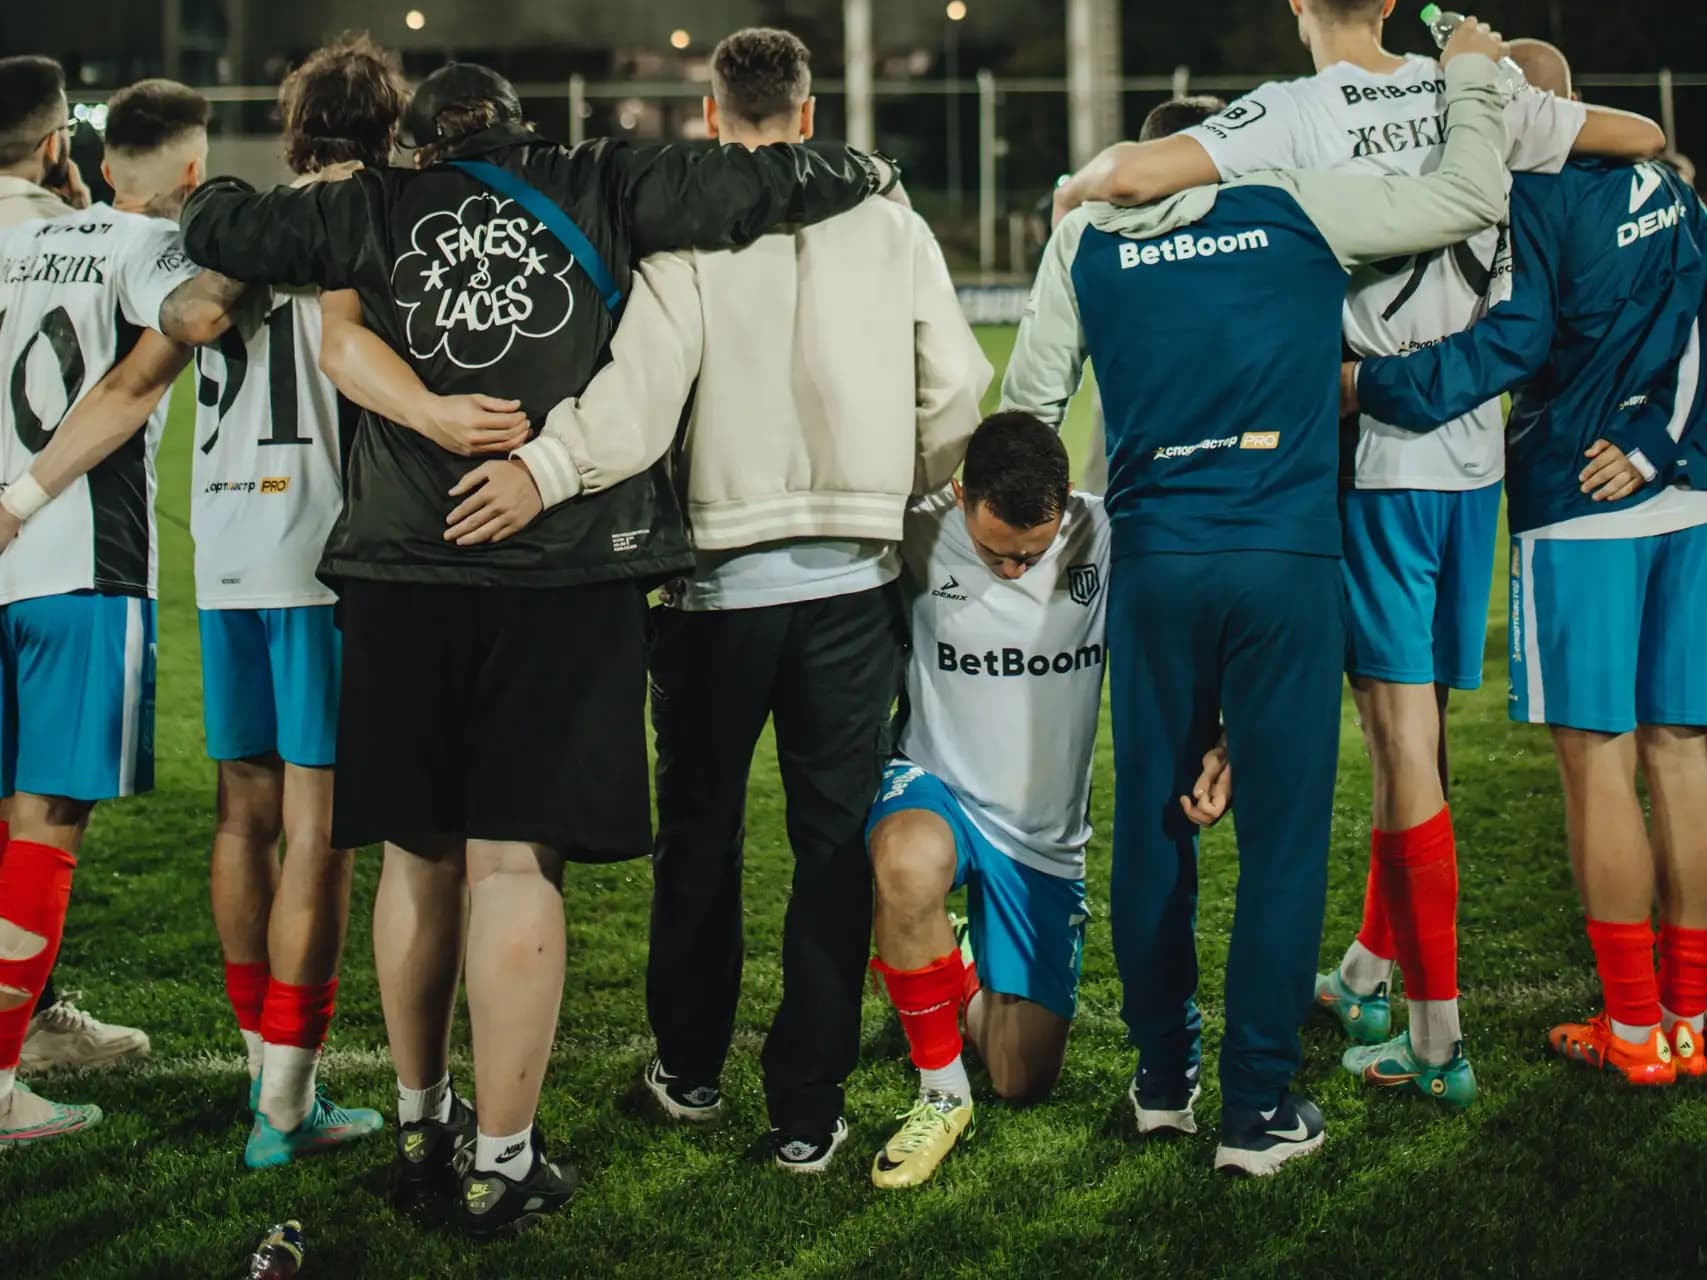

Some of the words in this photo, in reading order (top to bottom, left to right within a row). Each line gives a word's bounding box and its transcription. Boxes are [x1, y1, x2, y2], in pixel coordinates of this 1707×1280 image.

[435, 217, 529, 266] FACES
[1617, 200, 1686, 248] DEM
[1118, 228, 1269, 270] BetBoom
[435, 275, 533, 332] LACES
[261, 480, 287, 493] PRO
[931, 589, 969, 602] DEMIX
[937, 641, 1102, 677] BetBoom
